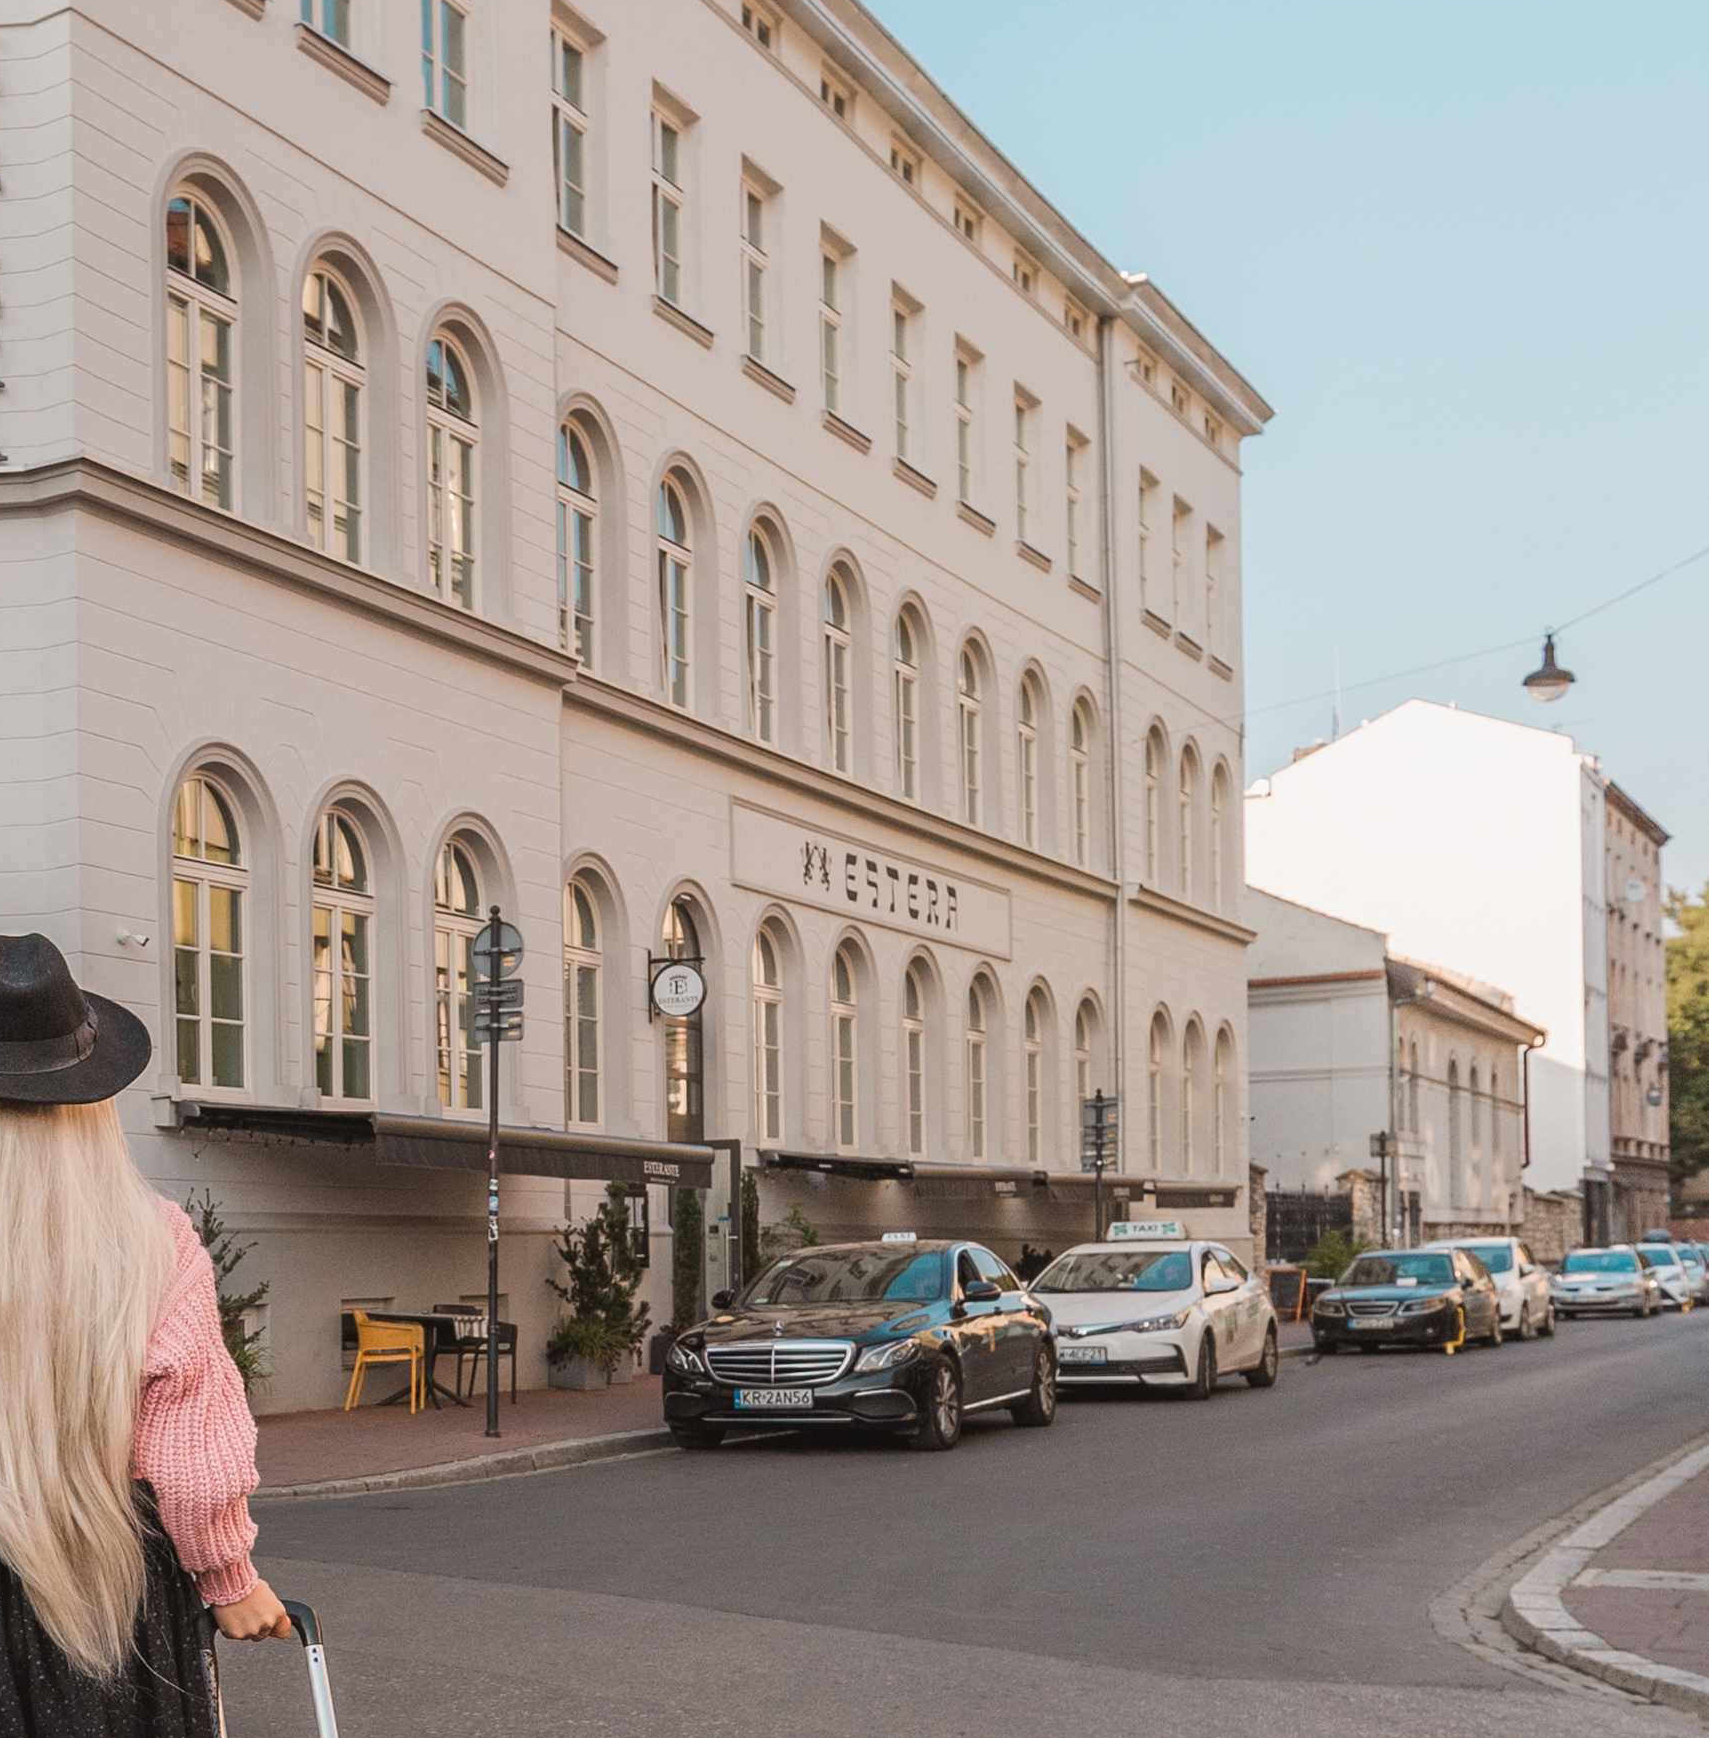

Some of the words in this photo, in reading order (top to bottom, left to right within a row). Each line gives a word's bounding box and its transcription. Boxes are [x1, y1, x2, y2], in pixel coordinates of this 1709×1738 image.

[845, 852, 958, 931] ESTERA
[674, 979, 685, 994] E
[658, 995, 699, 1004] ESTERANTE
[1132, 1224, 1158, 1232] TAXI
